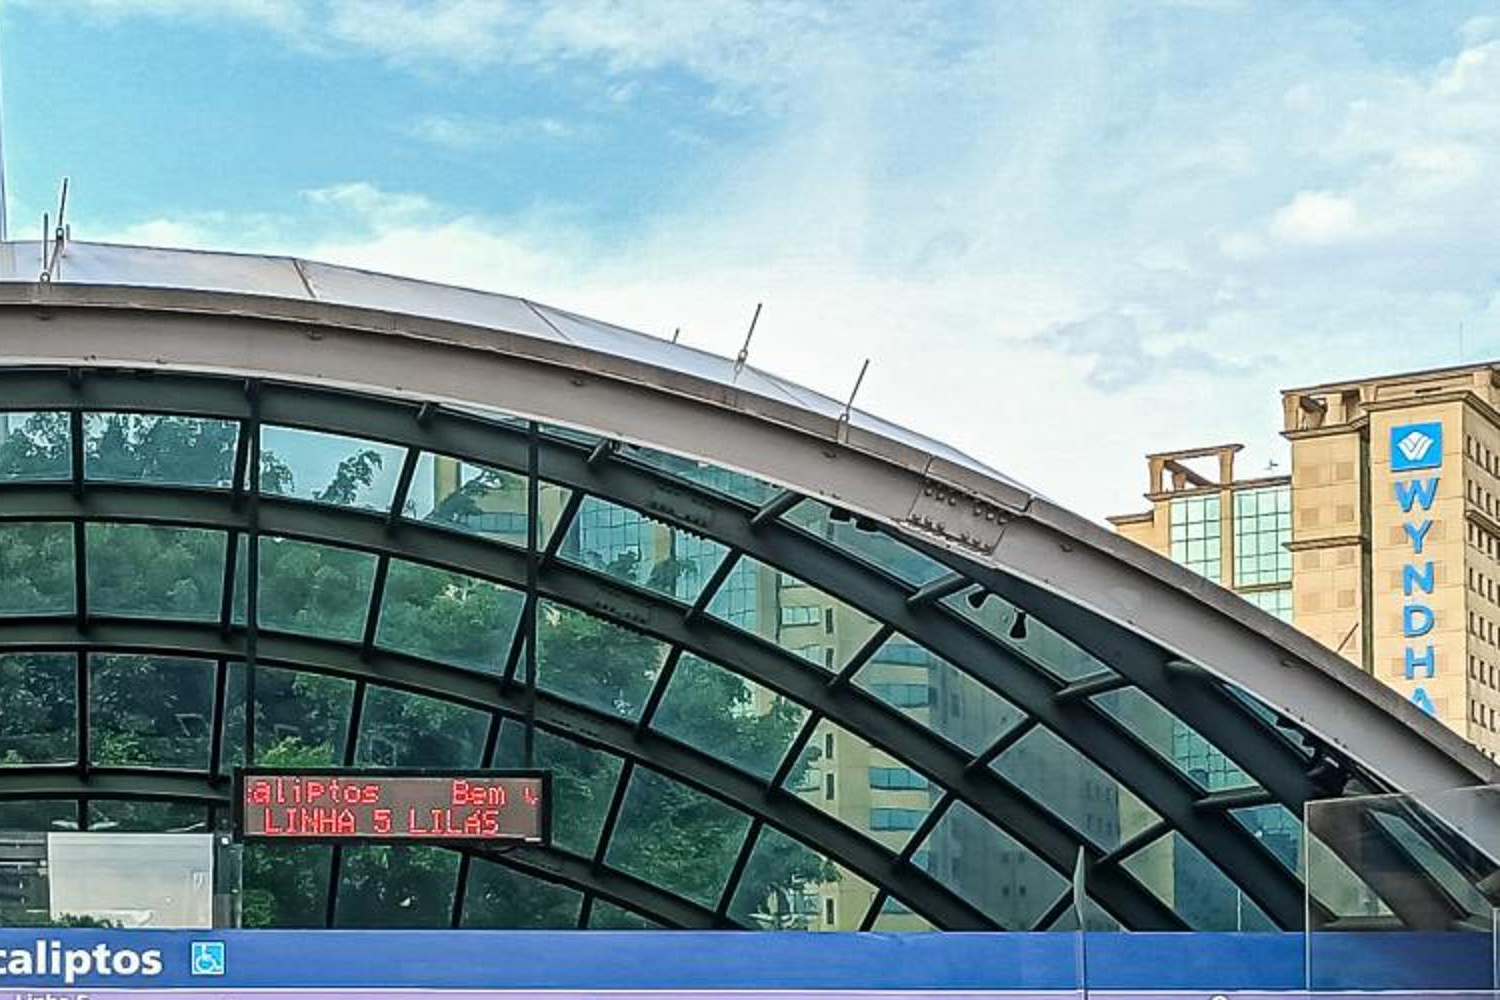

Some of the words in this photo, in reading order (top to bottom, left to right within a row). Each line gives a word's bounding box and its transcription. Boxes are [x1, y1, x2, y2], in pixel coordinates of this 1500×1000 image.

[247, 779, 379, 803] aliptos
[451, 779, 506, 804] Bem
[264, 808, 356, 834] LINHA
[373, 808, 392, 833] 5
